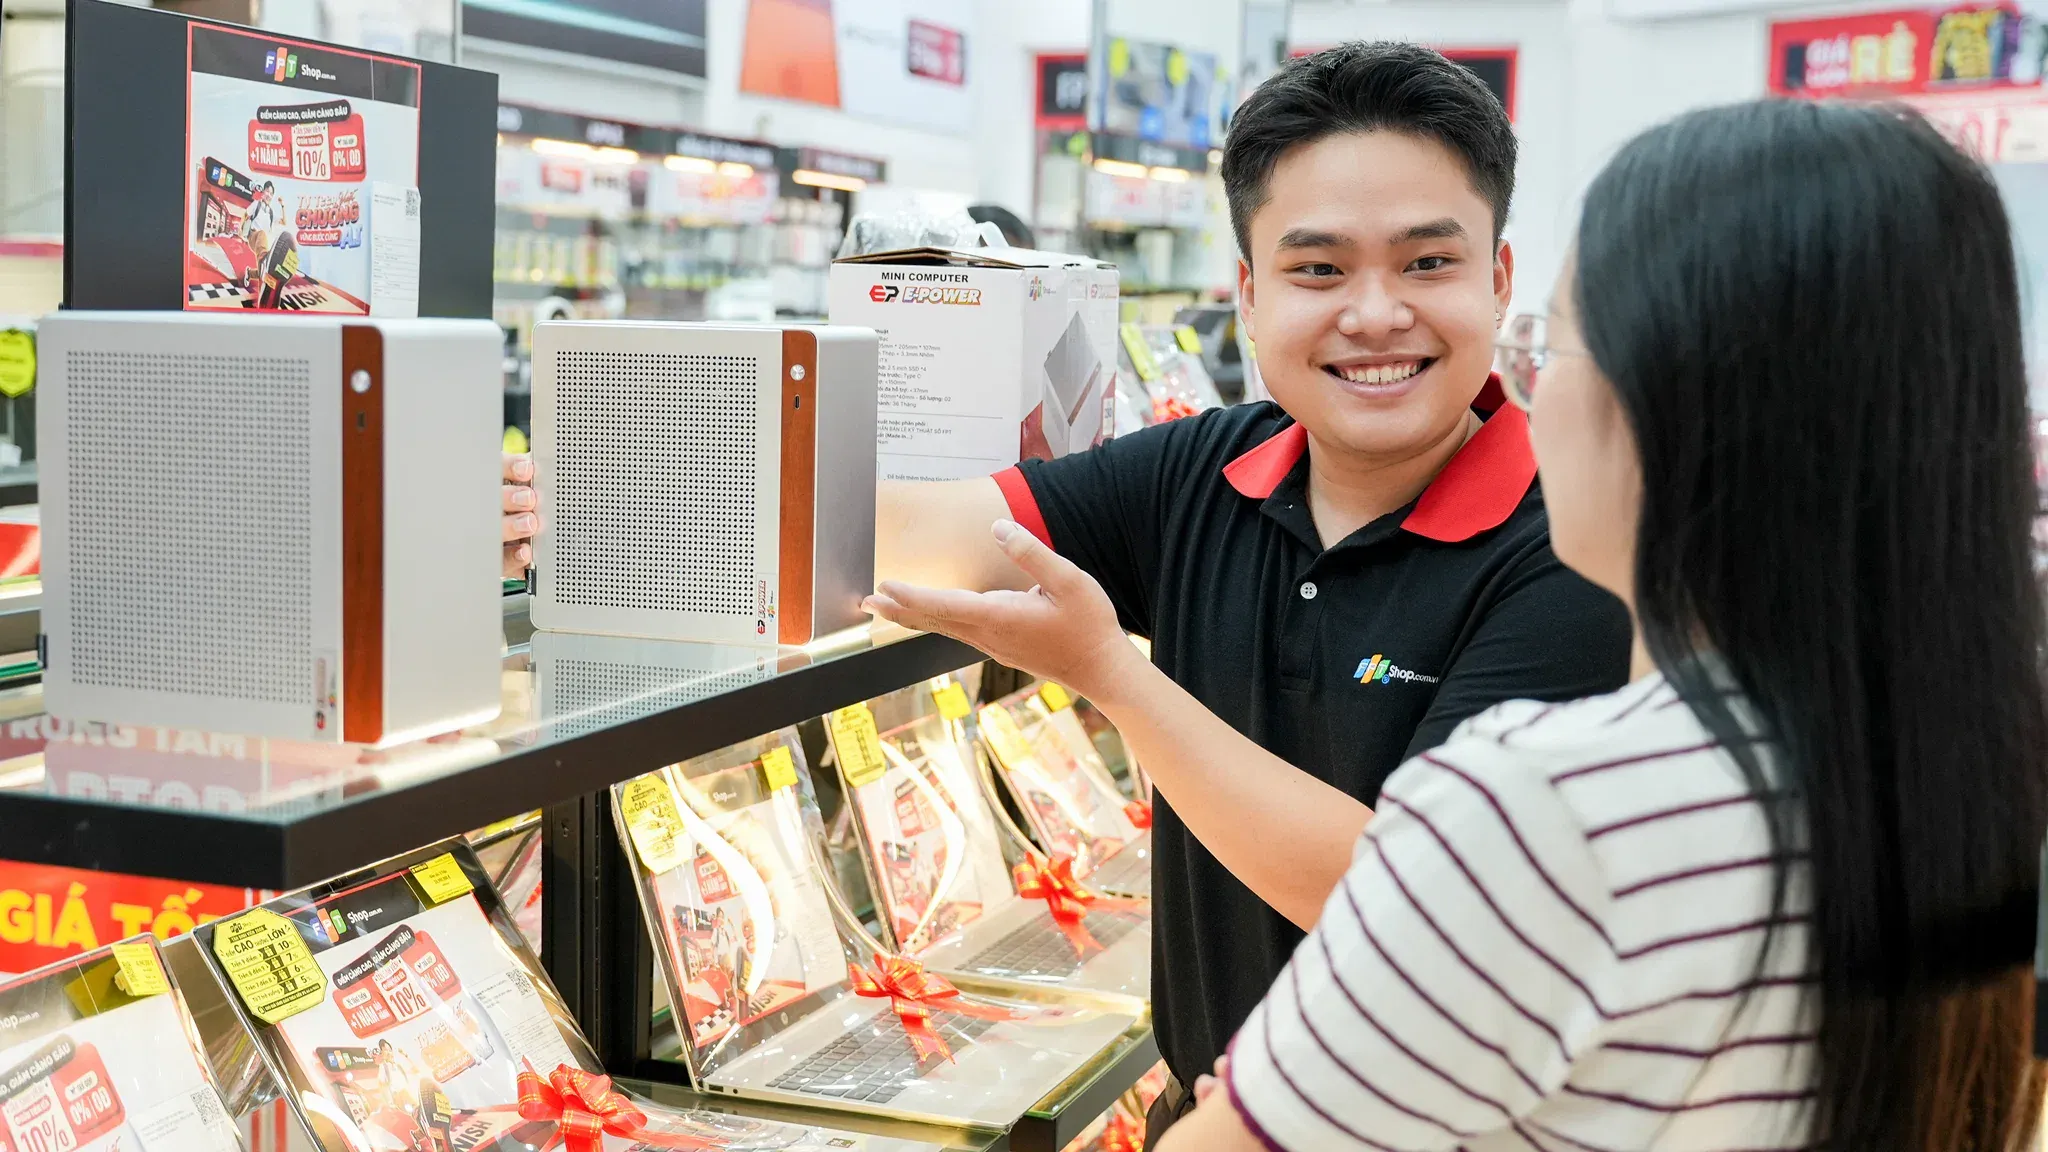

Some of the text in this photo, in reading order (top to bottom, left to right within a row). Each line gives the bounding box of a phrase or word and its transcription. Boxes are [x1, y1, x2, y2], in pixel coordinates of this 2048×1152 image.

[265, 51, 297, 77] FPT
[260, 144, 278, 166] NĂM
[296, 150, 326, 177] 10%
[881, 272, 969, 282] MINI COMPUTER
[280, 291, 328, 310] NISH
[902, 286, 981, 305] E-POWER
[1354, 658, 1390, 680] FPT
[635, 800, 648, 812] CAO
[0, 881, 229, 950] GIÁ TỐ
[311, 910, 344, 940] FPT
[234, 940, 254, 954] CAO
[267, 928, 286, 942] LỚN
[389, 982, 427, 1018] 10%
[358, 1004, 380, 1027] NĂM
[29, 1054, 54, 1077] CÀNG
[70, 1098, 92, 1126] 0%
[21, 1114, 69, 1152] 10%
[454, 1120, 493, 1152] NISH
